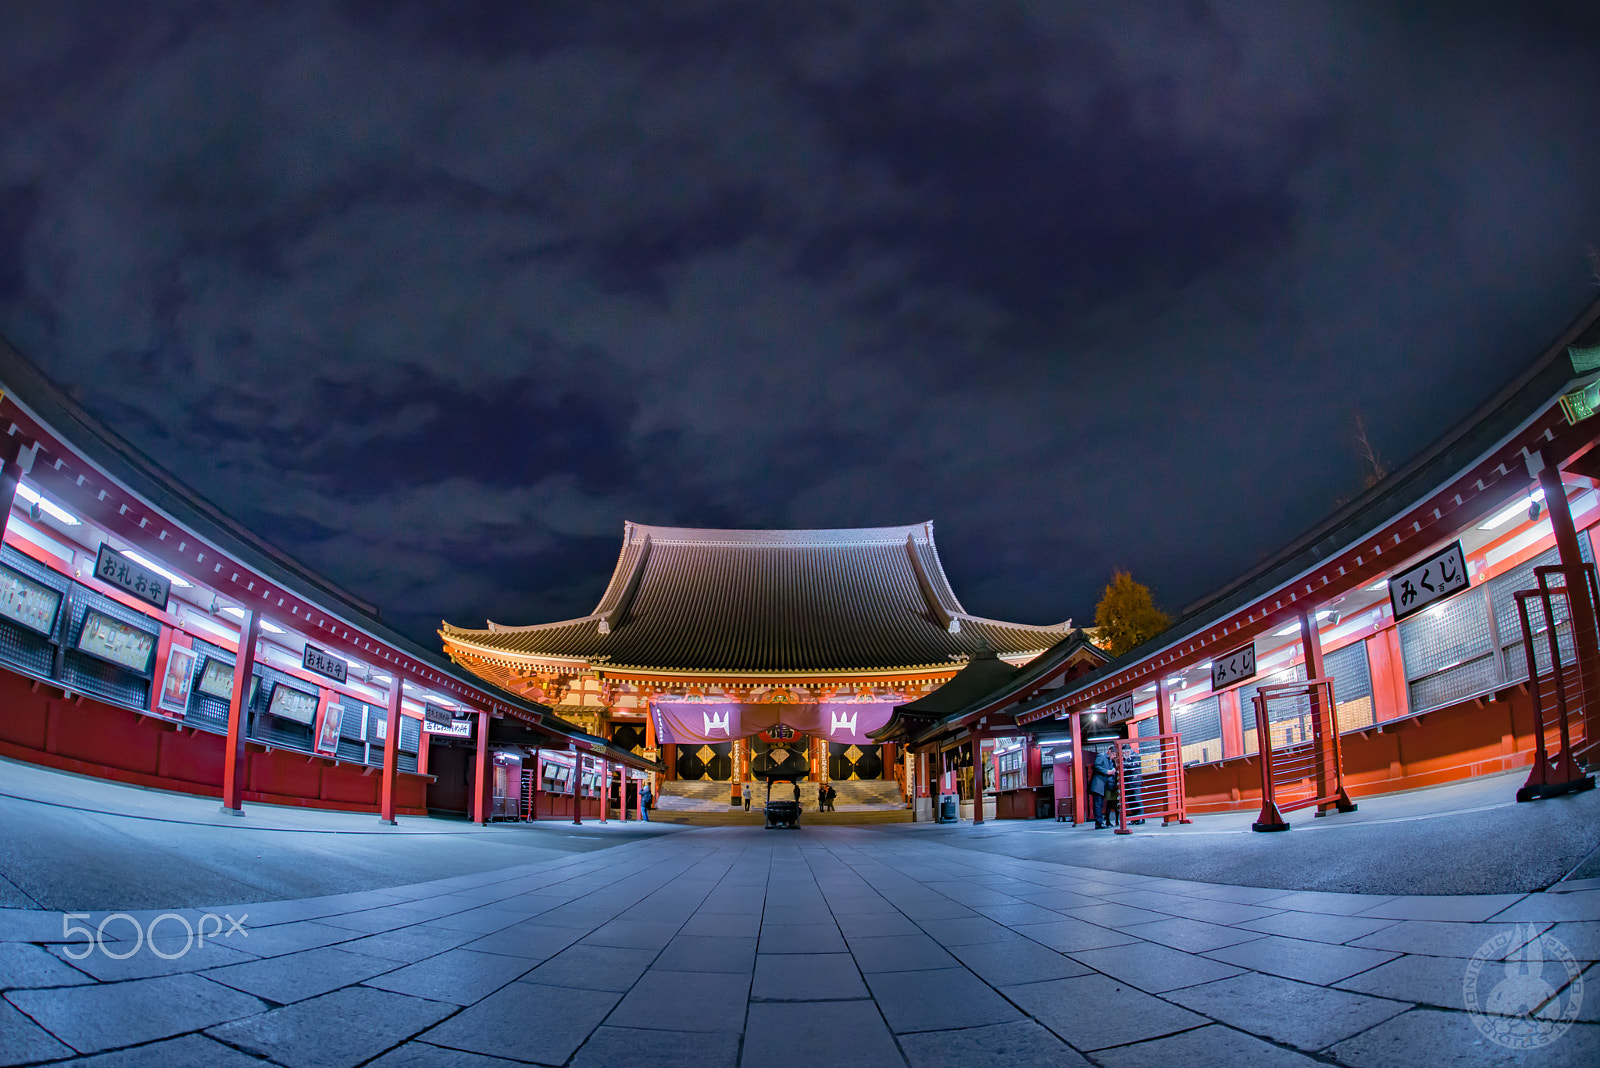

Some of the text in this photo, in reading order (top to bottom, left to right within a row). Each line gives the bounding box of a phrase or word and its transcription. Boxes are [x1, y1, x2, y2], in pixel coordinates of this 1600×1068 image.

[103, 555, 162, 600] お札お守
[1400, 555, 1457, 607] みくじ
[307, 651, 342, 677] お札お守
[1217, 651, 1251, 681] みくじ
[1110, 701, 1131, 720] みくじ
